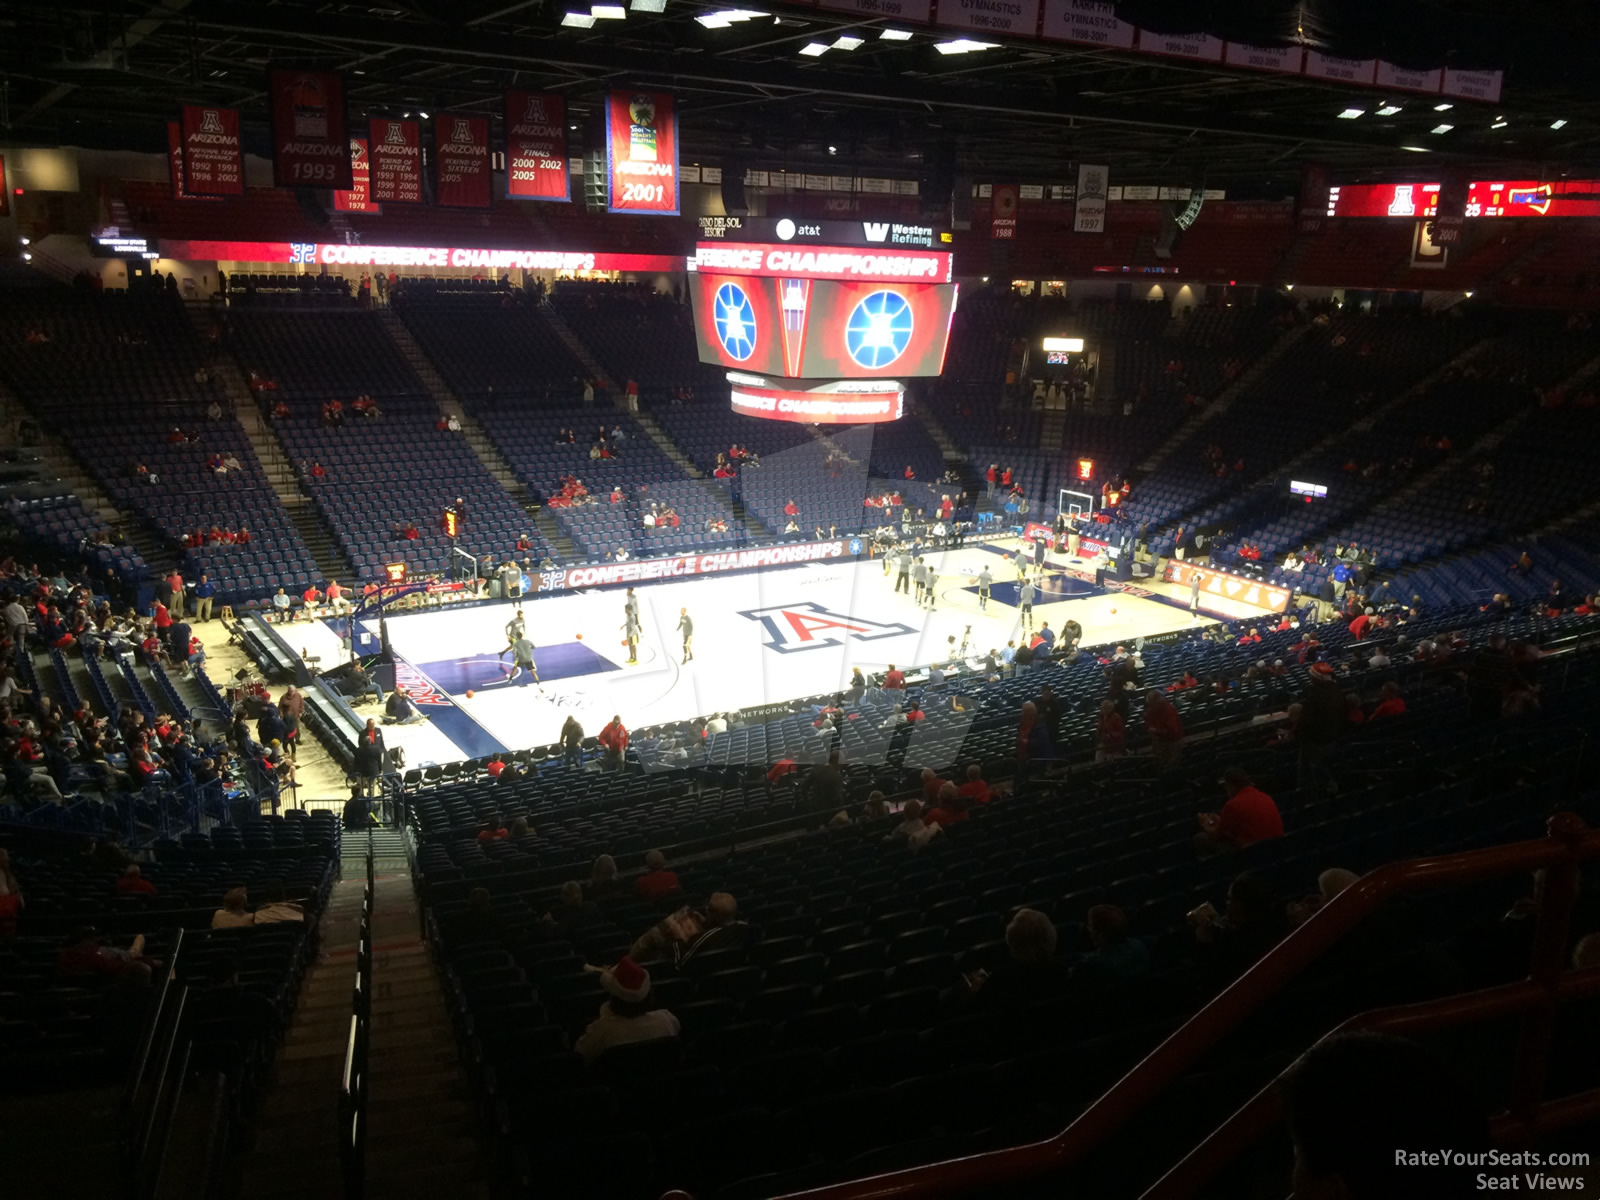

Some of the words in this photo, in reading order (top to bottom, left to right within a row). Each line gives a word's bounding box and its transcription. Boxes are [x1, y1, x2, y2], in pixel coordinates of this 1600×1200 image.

[1064, 12, 1118, 29] GYMNASTICS
[511, 124, 563, 137] ARIZONA
[188, 133, 238, 145] ARIZONA
[282, 143, 343, 157] ARIZONA
[374, 144, 419, 156] ARIZONA
[440, 143, 487, 156] ARIZONA
[523, 149, 550, 158] FINALS
[379, 157, 402, 165] ROUND
[512, 158, 535, 168] 2000
[540, 160, 562, 170] 2002
[192, 162, 211, 171] 1992
[217, 163, 237, 172] 1993
[292, 162, 336, 180] 1993
[381, 164, 412, 172] SIXTEEN
[447, 165, 480, 173] SIXTEEN
[616, 161, 672, 176] ARIZONA
[192, 172, 212, 181] 1996
[217, 173, 238, 182] 2002
[376, 171, 395, 179] 1993
[400, 172, 418, 181] 1994
[441, 173, 462, 182] 2005
[512, 170, 535, 181] 2005
[376, 181, 395, 189] 1999
[399, 182, 418, 191] 2000
[348, 193, 365, 201] 1977
[376, 190, 395, 199] 2001
[399, 191, 418, 200] 2002
[623, 183, 663, 202] 2001
[348, 202, 366, 210] 1978
[726, 217, 742, 228] SOL
[1080, 219, 1099, 229] 1997
[798, 225, 821, 236] at&t
[892, 223, 932, 235] Western
[892, 233, 931, 247] Refining
[321, 244, 448, 266] CONFERENCE
[452, 249, 595, 270] CHAMPIONSHIPS
[766, 251, 938, 277] CHAMPIONSHIPS
[568, 557, 697, 587] CONFERENCE
[700, 541, 843, 573] CHAMPIONSHIPS
[740, 705, 789, 719] NETWORKS
